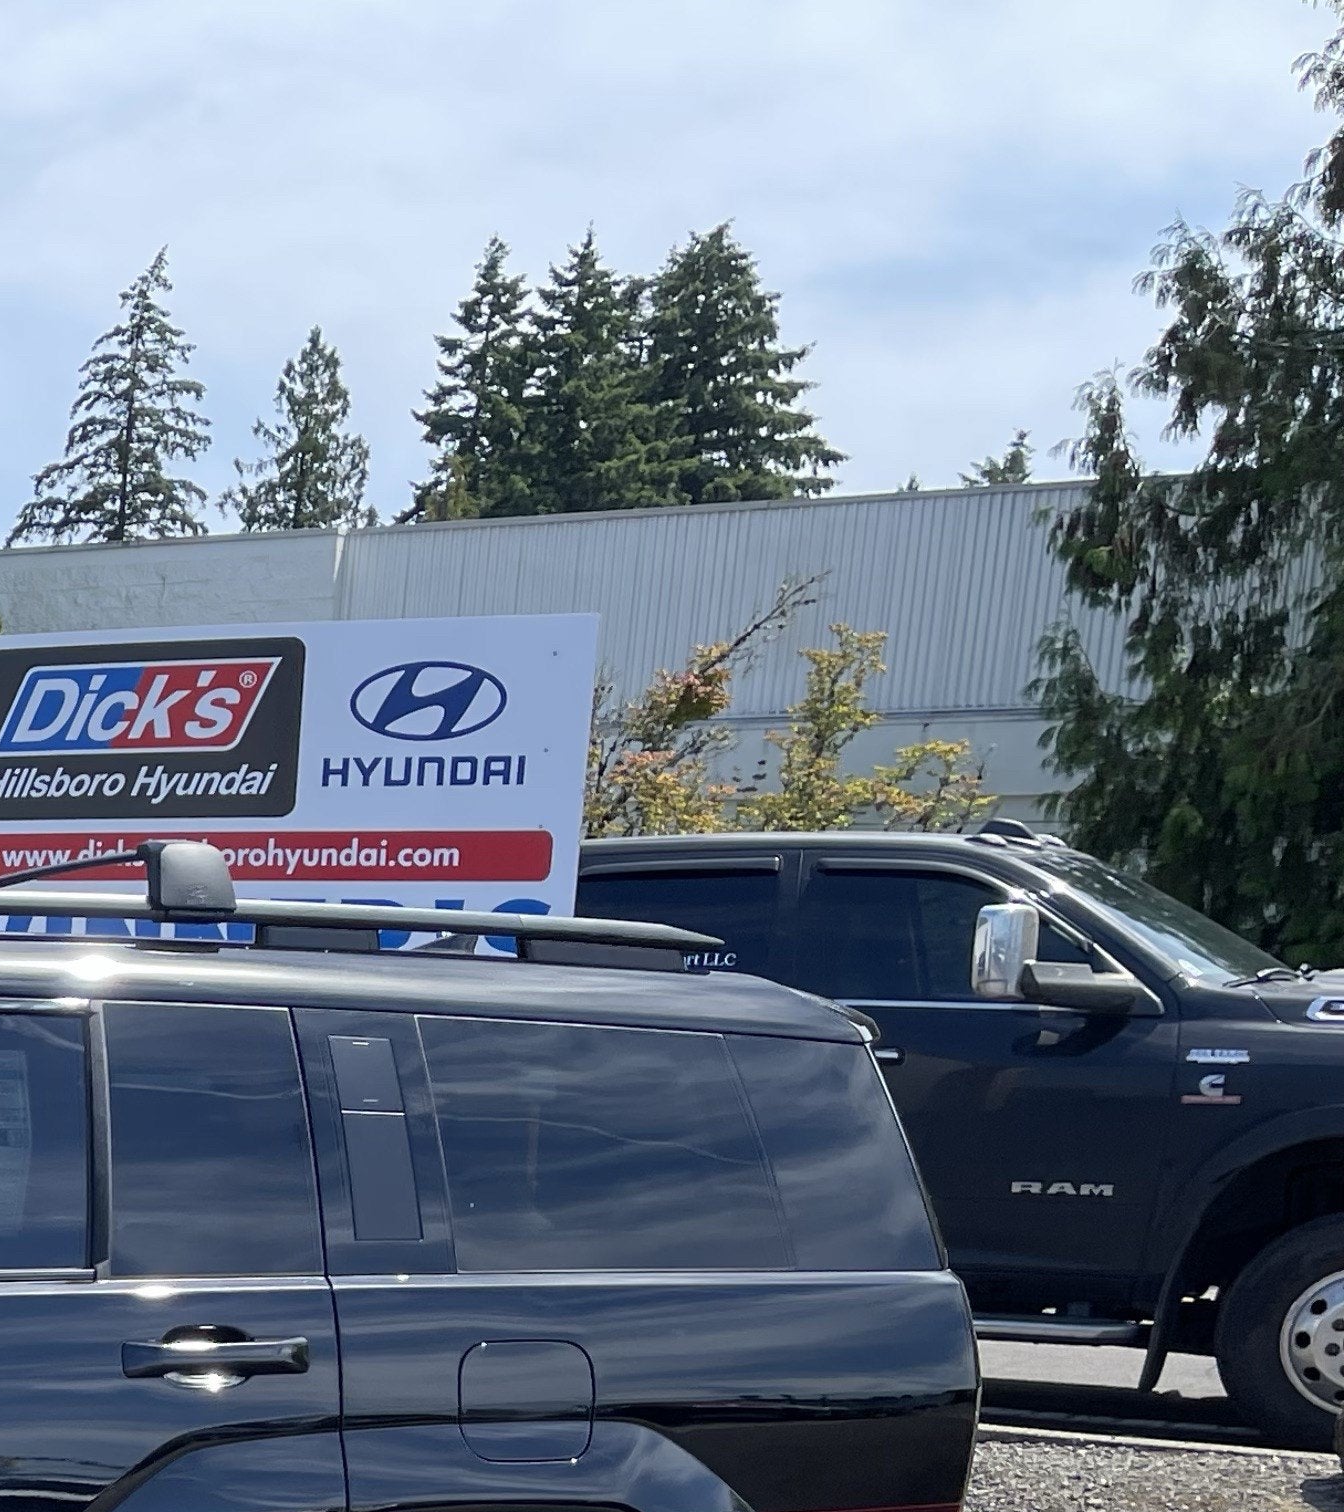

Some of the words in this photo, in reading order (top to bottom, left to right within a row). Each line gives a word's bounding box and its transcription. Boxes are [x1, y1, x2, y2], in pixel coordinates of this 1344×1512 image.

[11, 670, 241, 742] Dick's
[130, 763, 279, 803] Hyundai
[321, 756, 526, 786] HYUNDAI
[703, 953, 737, 966] LLC
[1011, 1181, 1114, 1196] RAM
